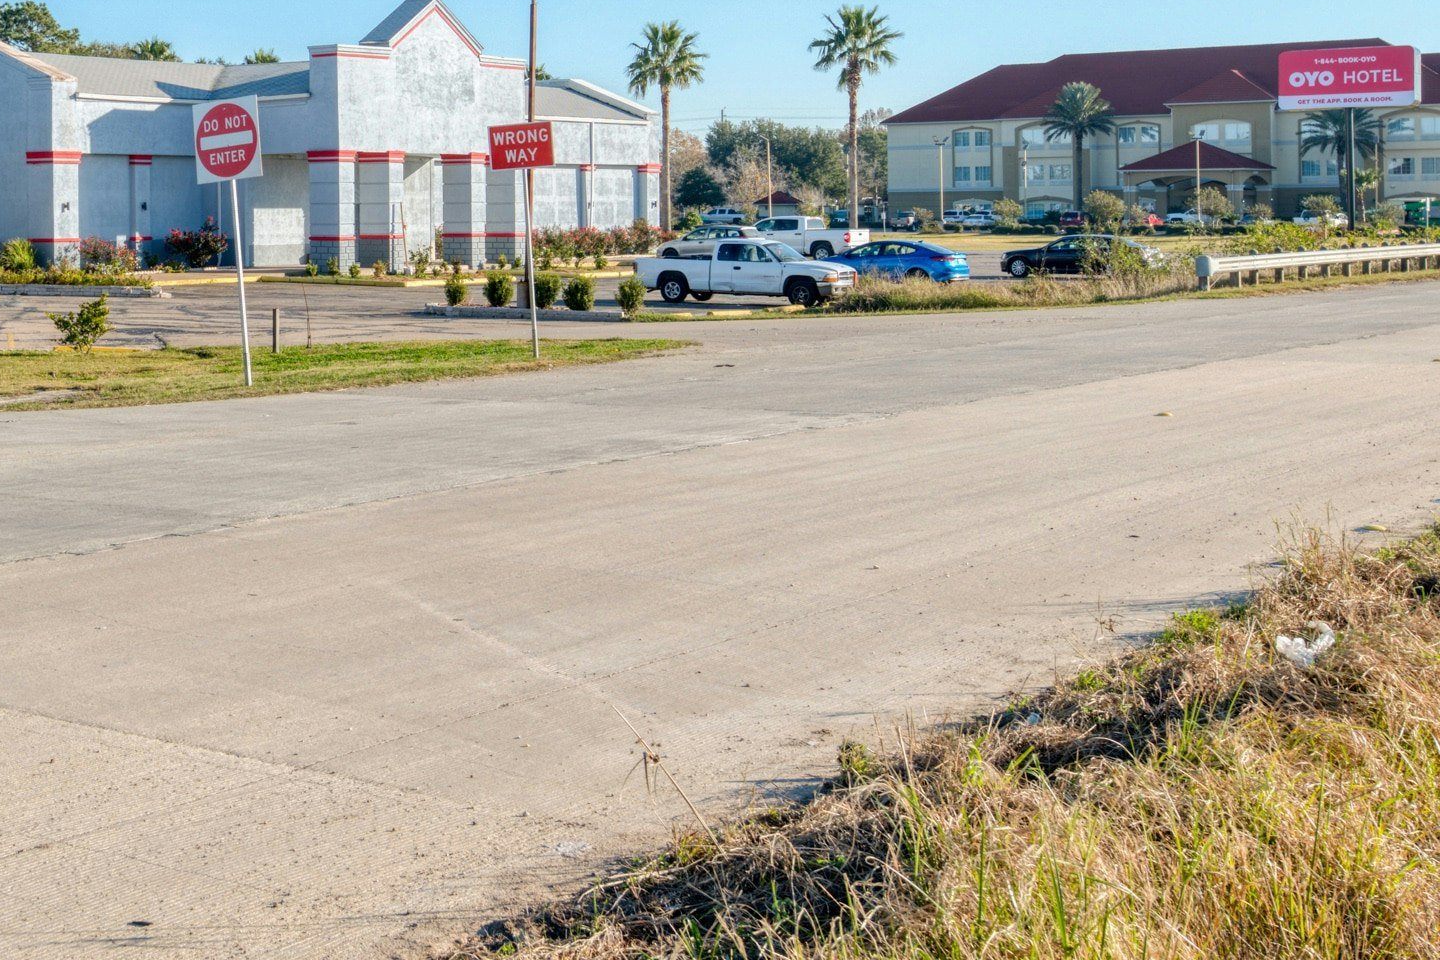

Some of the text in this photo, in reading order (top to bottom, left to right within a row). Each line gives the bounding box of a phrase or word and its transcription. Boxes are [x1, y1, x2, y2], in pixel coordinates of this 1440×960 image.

[1288, 68, 1403, 88] OYO HOTEL
[203, 114, 247, 133] DO NOT
[492, 128, 549, 146] WRONG
[209, 149, 246, 166] ENTER
[504, 147, 538, 163] WAY
